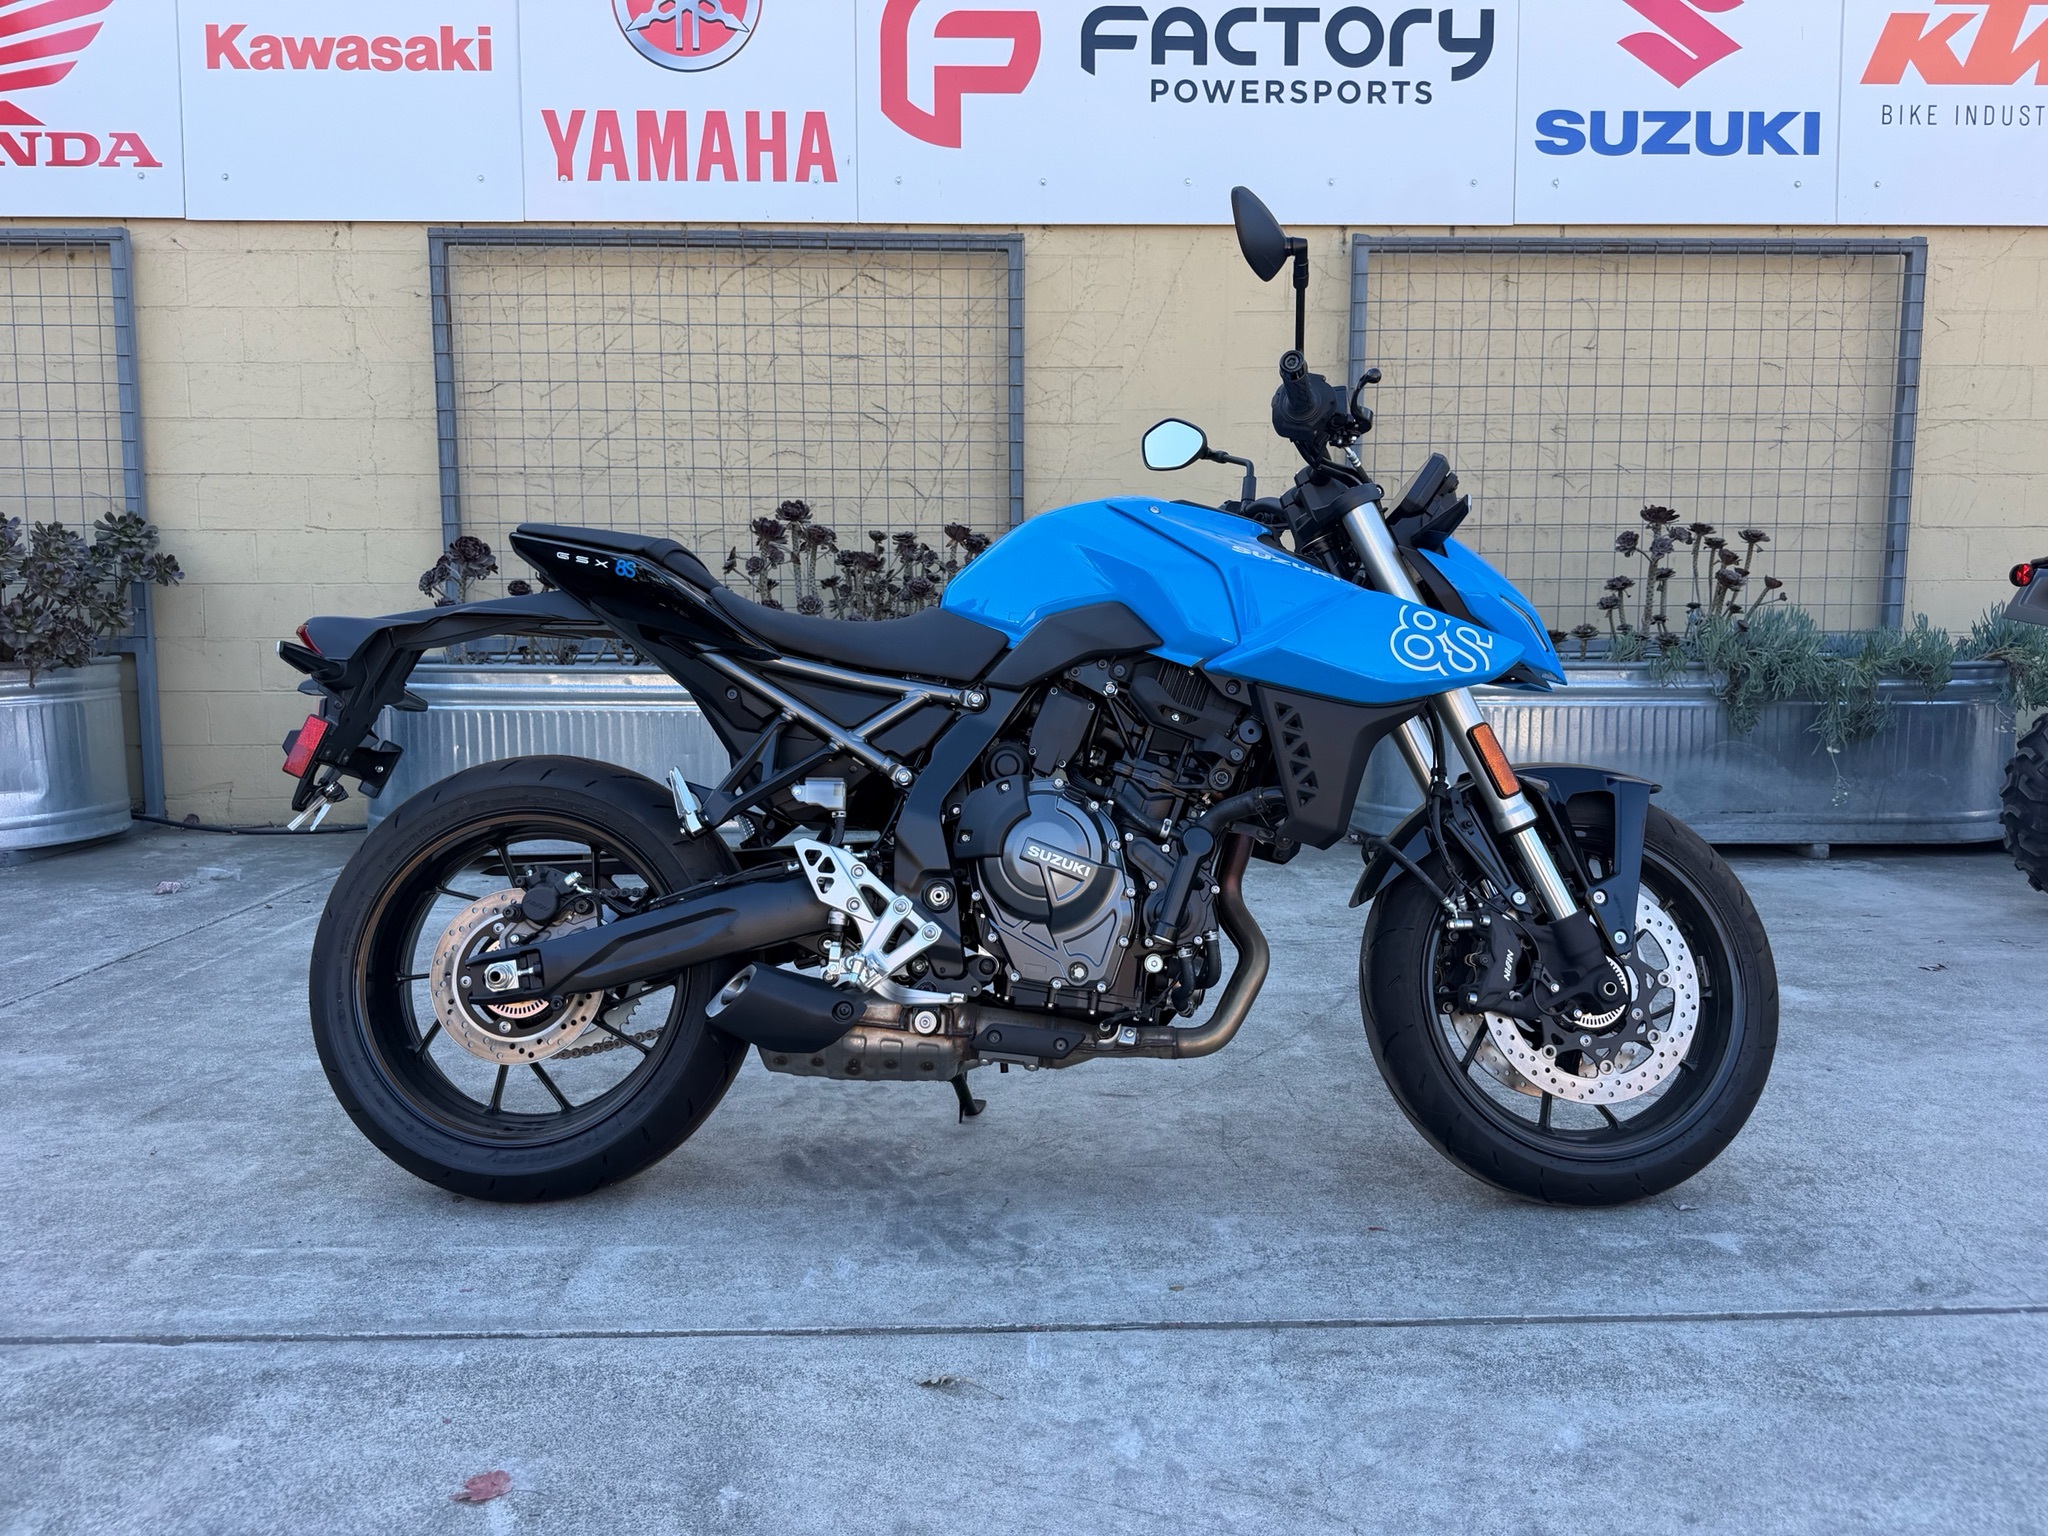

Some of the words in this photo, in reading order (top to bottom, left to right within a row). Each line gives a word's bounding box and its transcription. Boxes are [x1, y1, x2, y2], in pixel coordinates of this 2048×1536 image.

[205, 24, 491, 71] Kawasaki
[1151, 79, 1432, 105] POWERSPORTS
[1881, 105, 1938, 126] BIKE
[541, 109, 838, 182] YAMAHA
[1534, 109, 1820, 157] SUZUKI
[556, 551, 609, 569] GSX
[1027, 845, 1091, 877] SUZUKI
